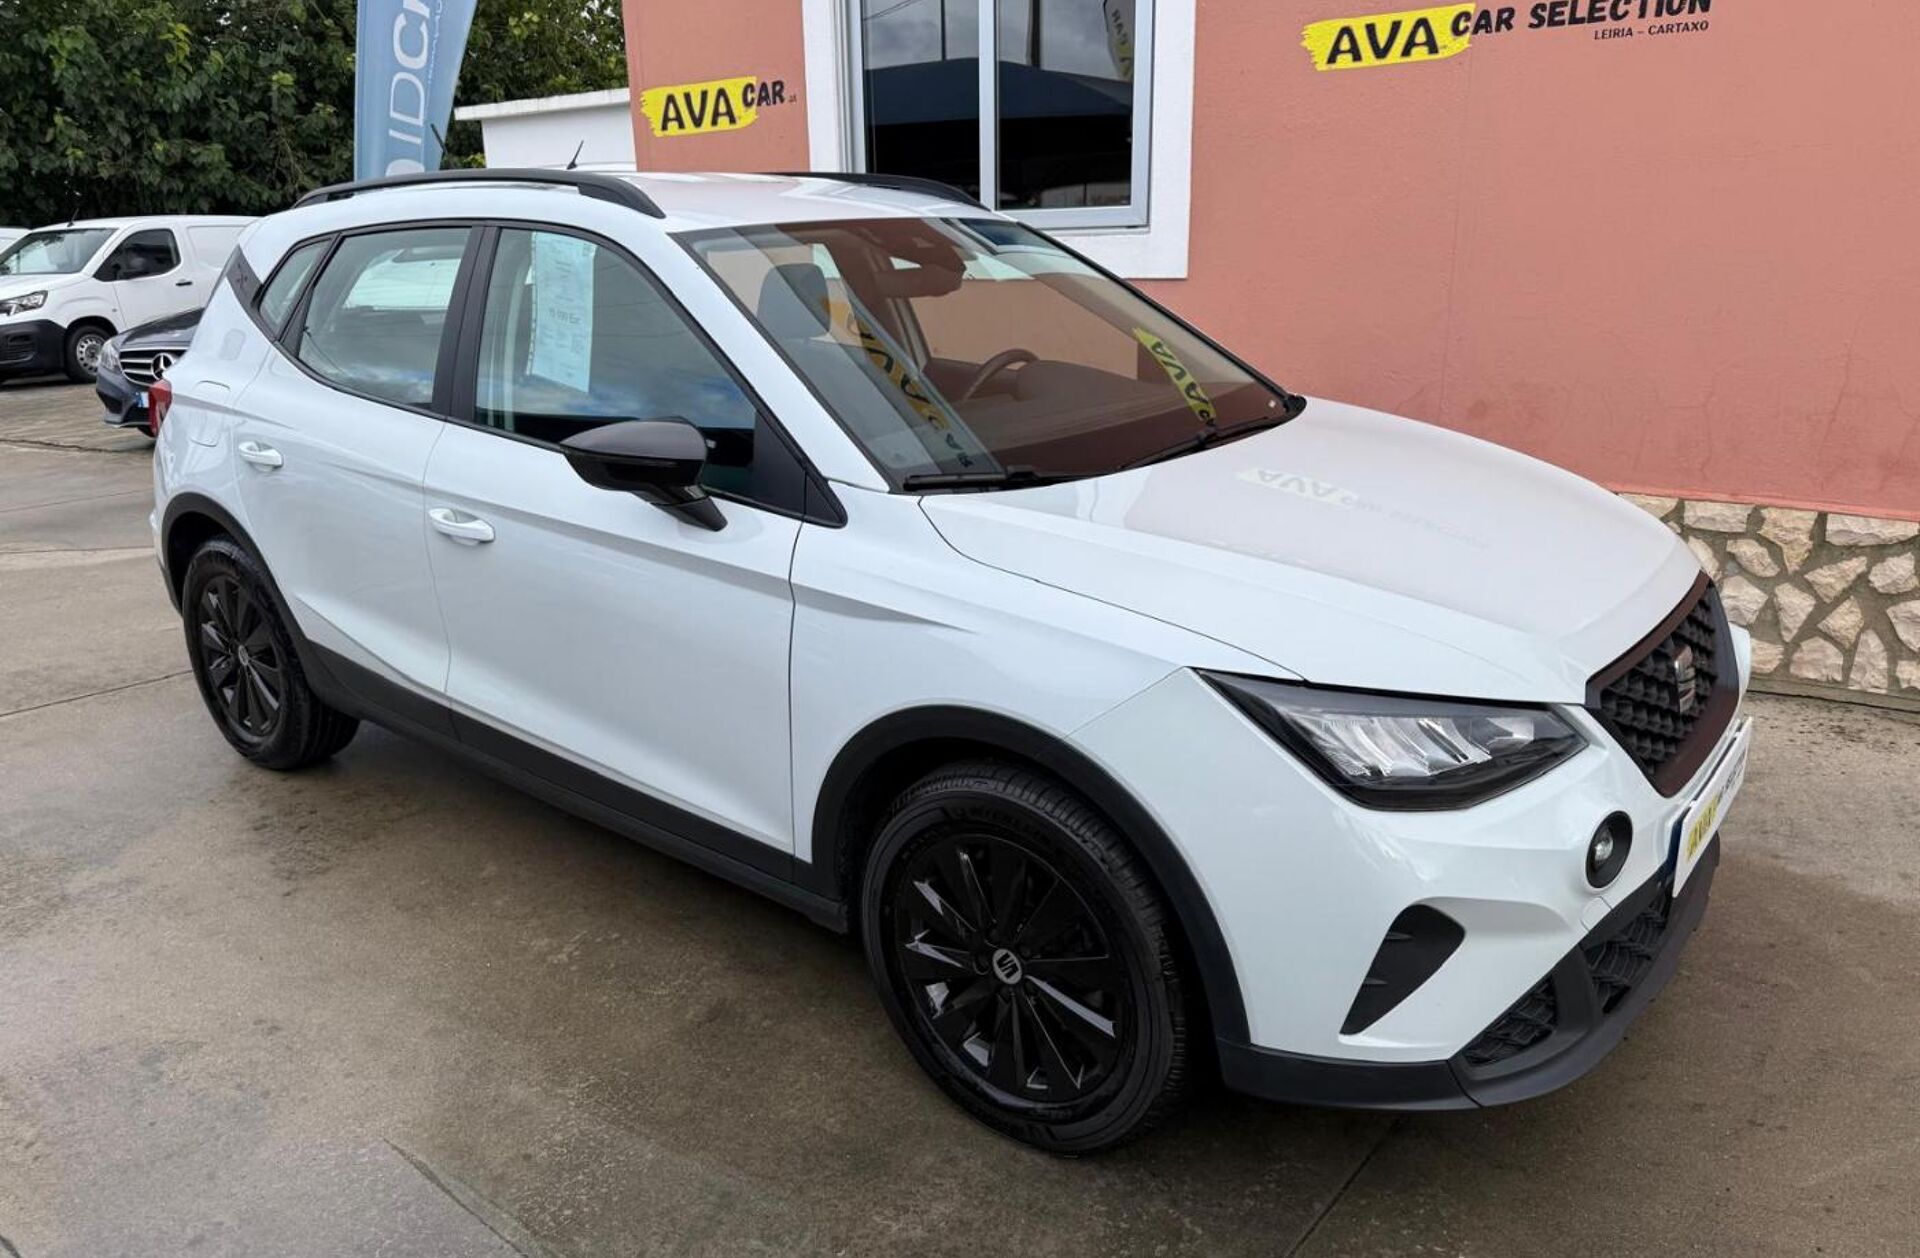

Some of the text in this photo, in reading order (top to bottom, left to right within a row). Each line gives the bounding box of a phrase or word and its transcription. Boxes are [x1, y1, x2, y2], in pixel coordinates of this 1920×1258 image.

[1327, 17, 1439, 64] AVA
[1452, 7, 1515, 36] CAR
[1594, 27, 1633, 40] LEIRIA
[1648, 20, 1709, 36] CARTAXO
[661, 80, 785, 131] AVA CAR
